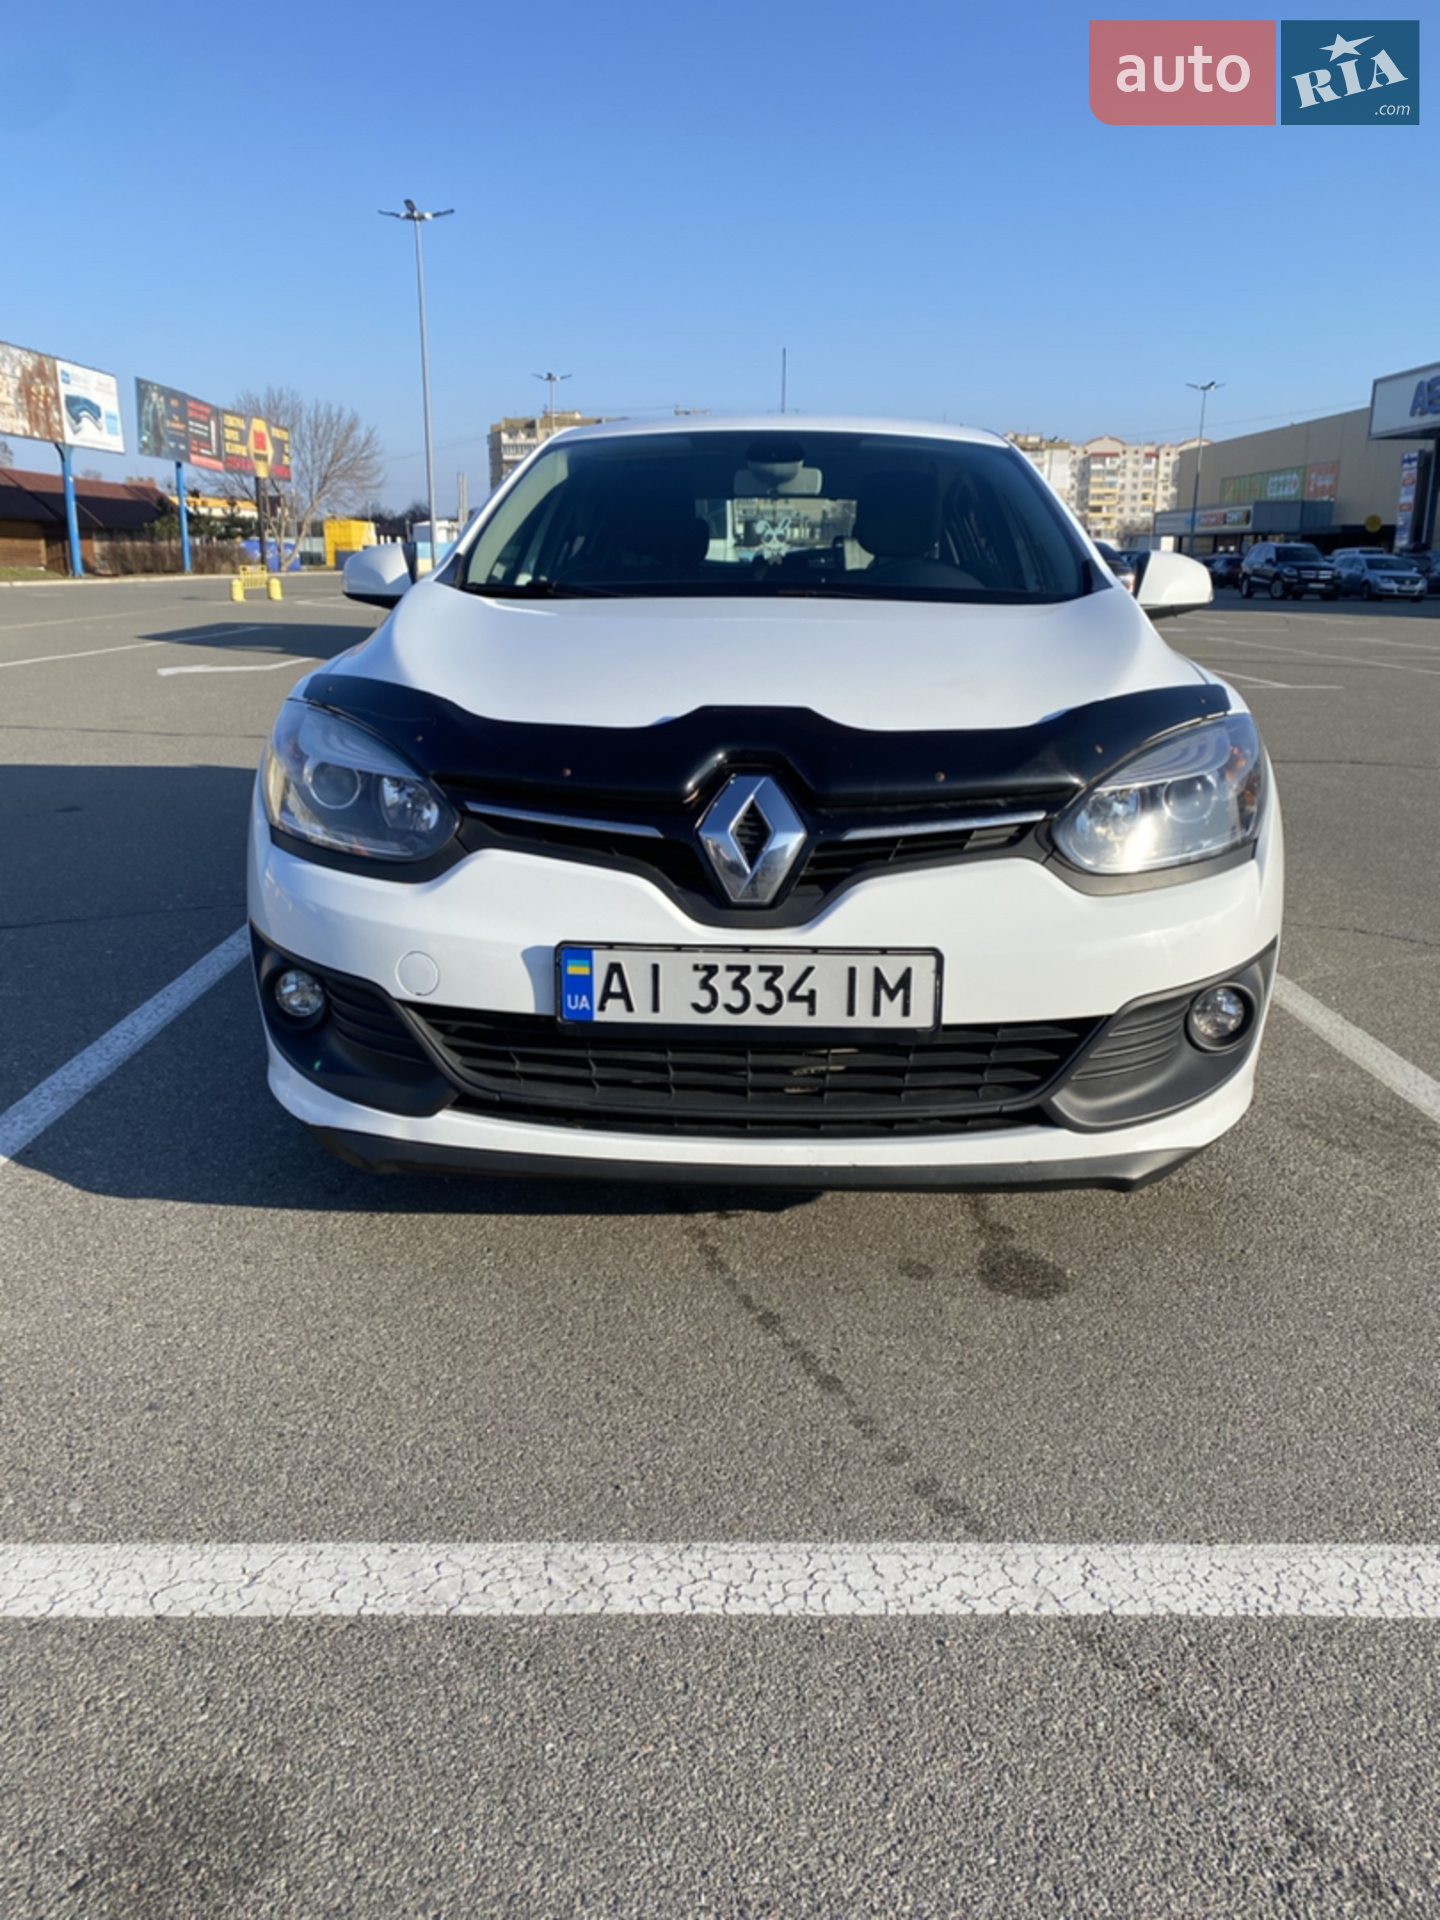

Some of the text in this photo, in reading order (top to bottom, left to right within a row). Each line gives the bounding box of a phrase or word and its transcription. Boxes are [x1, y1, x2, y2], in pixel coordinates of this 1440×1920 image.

[566, 995, 590, 1010] UA
[598, 962, 912, 1017] AI 3334 IM
